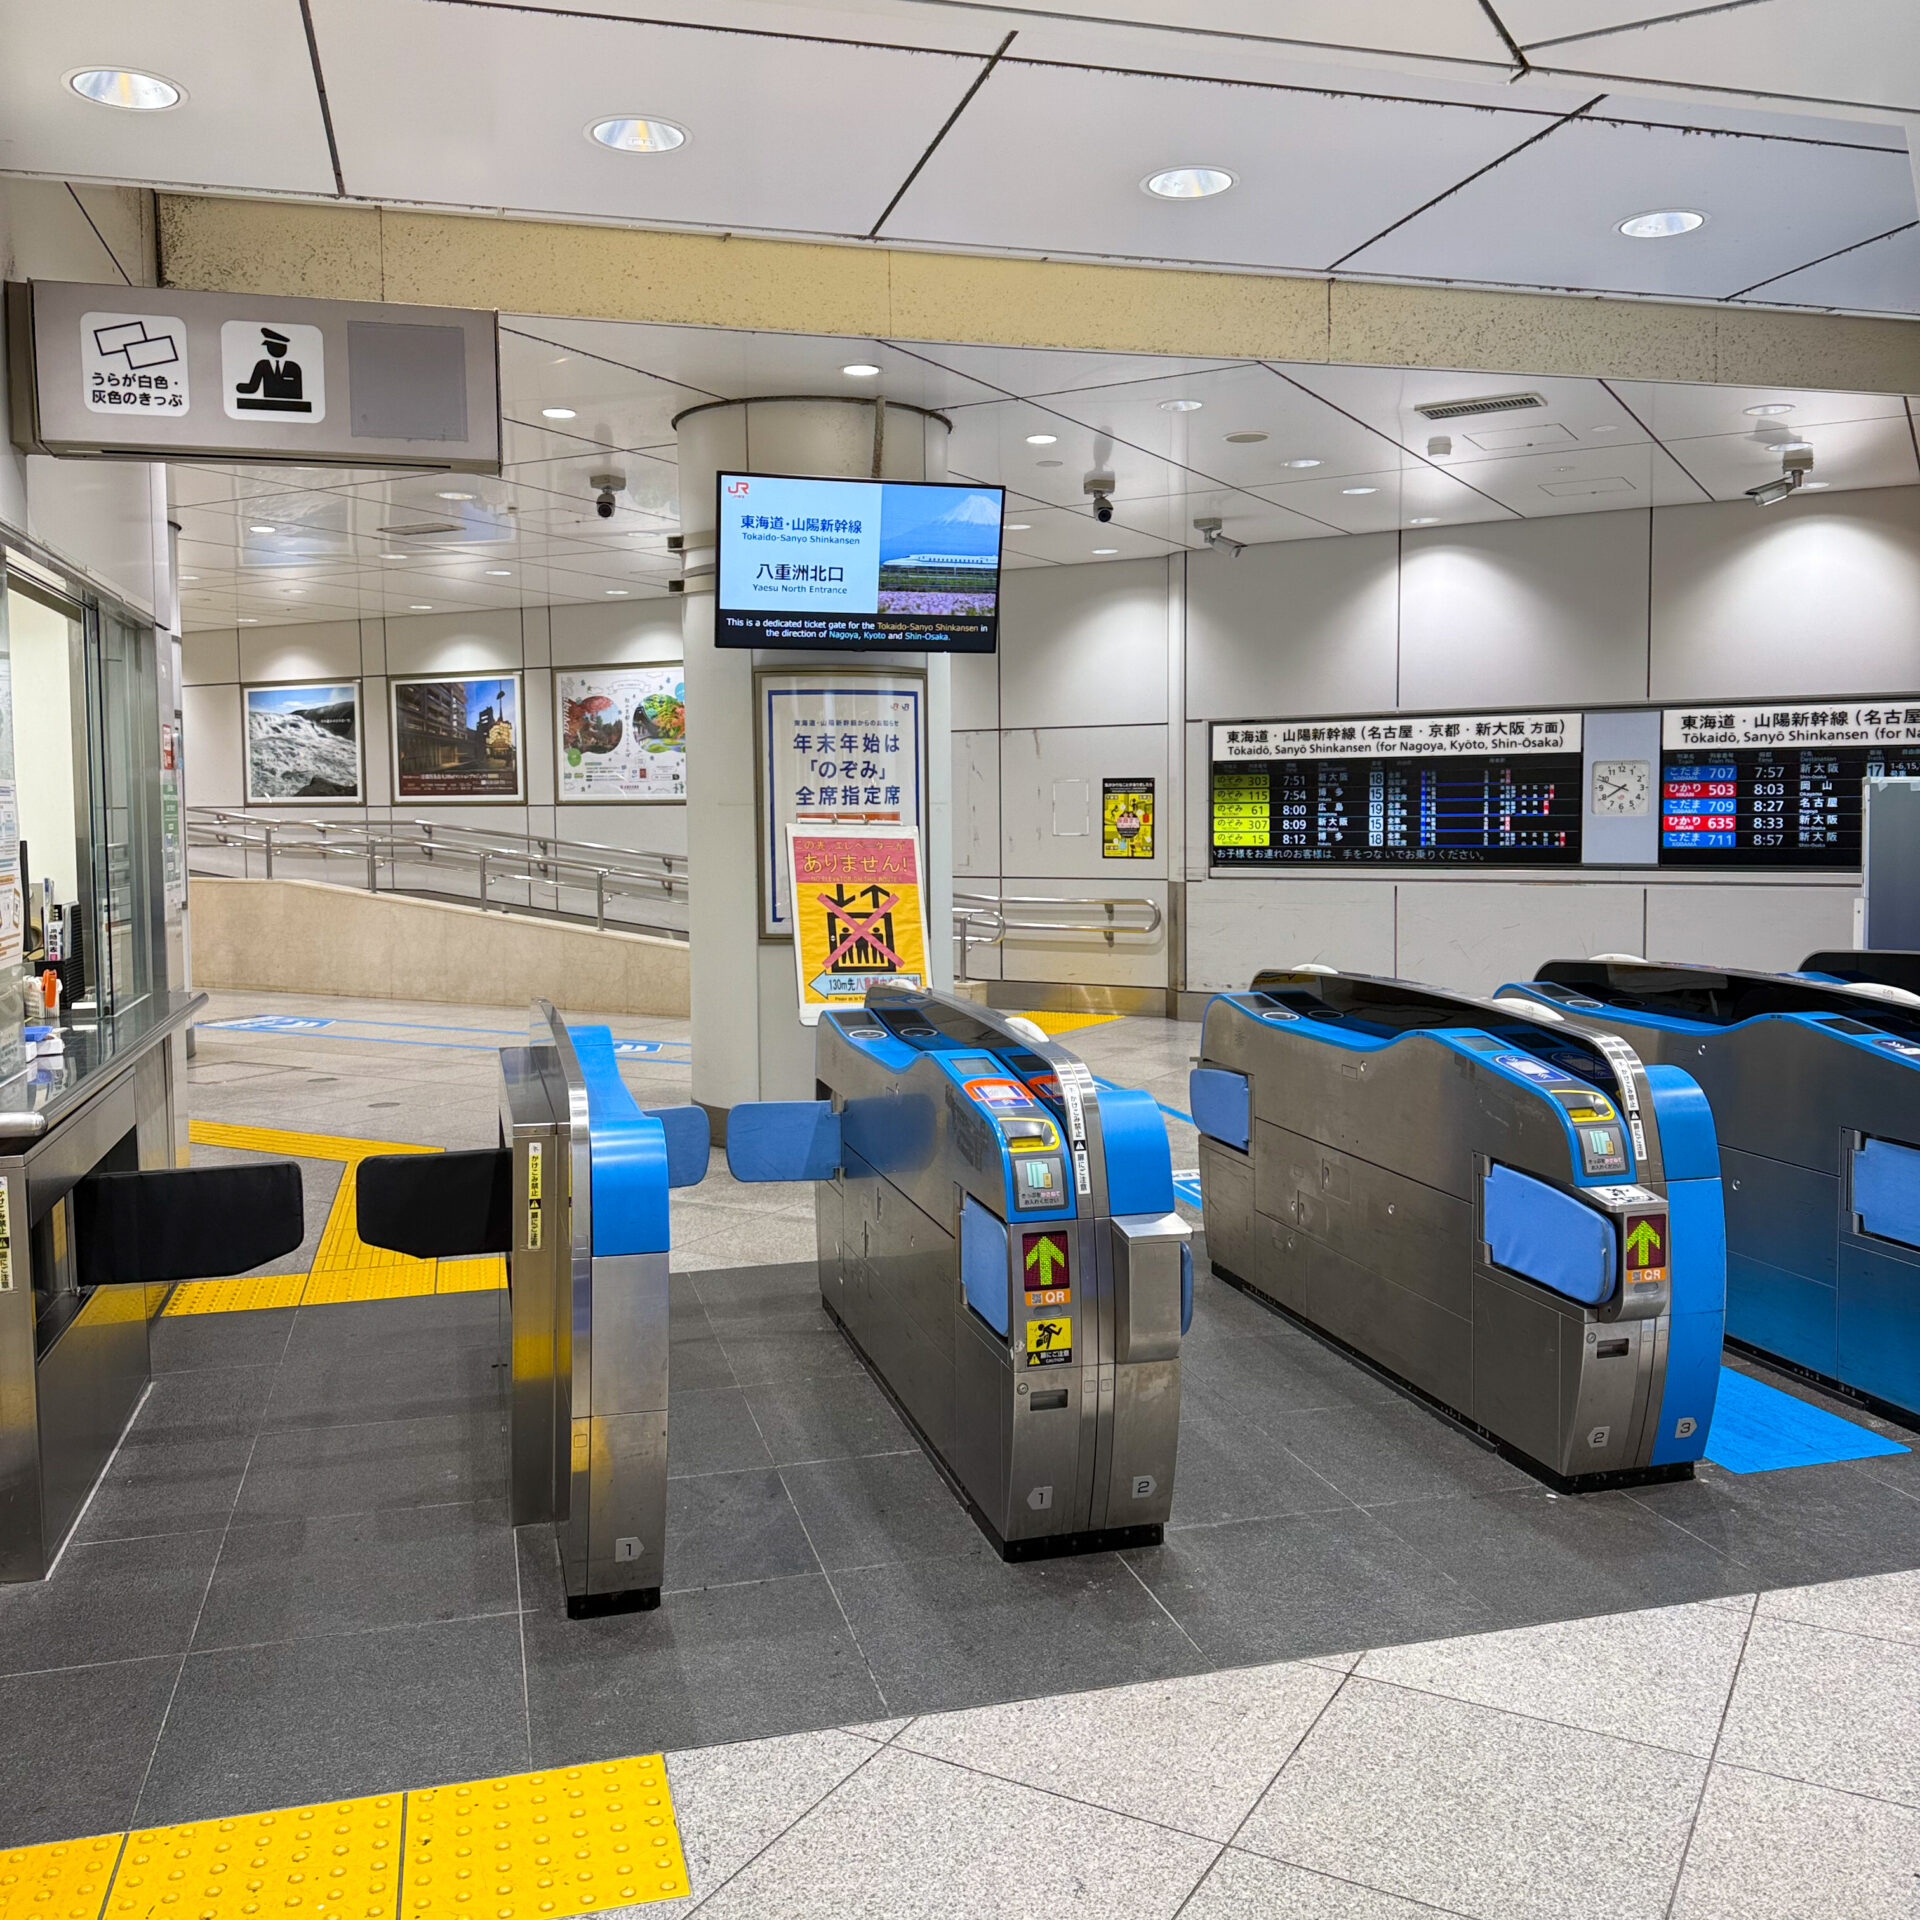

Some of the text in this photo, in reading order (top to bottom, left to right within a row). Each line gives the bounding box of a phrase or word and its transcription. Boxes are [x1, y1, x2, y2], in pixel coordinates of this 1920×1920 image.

[92, 372, 178, 389] うらが白色・
[92, 390, 182, 407] 灰色のきっぷ
[728, 482, 749, 494] JR
[741, 515, 862, 534] 東海道・山陽新幹線
[742, 532, 860, 544] Tokaido-Sanyo Shinkansen
[756, 563, 844, 582] 八重洲北口
[753, 584, 847, 594] Yaesu North Entrance
[727, 617, 743, 626] This
[746, 618, 753, 627] is
[763, 618, 802, 628] dedicated
[804, 619, 827, 629] ticket
[828, 620, 847, 632] gate
[848, 620, 860, 630] for
[862, 621, 875, 630] the
[877, 622, 933, 634] Tokaido-Sanyo
[936, 623, 979, 632] Shinkansen
[981, 623, 988, 632] in
[766, 628, 950, 642] the direction of Nagoya, Kyoto and Shin-Osaka.
[1744, 731, 1785, 744] Sanyō
[1789, 728, 1869, 741] Shinkansen
[1875, 727, 1903, 740] (for
[793, 733, 900, 754] 年末年始は
[1275, 744, 1306, 756] Sanyō
[1310, 742, 1371, 754] Shinkansen
[1376, 741, 1397, 752] (for
[1400, 739, 1447, 753] Nagoya,
[1450, 738, 1488, 751] Kyōto,
[810, 759, 886, 780] 「のぞみ」
[1670, 763, 1883, 779] こだま 707 7:57 新大阪 17
[1248, 776, 1268, 786] 303
[1284, 776, 1305, 785] 7:51
[1371, 774, 1382, 785] 18
[1249, 791, 1268, 800] 115
[1284, 790, 1306, 800] 7:54
[1318, 787, 1343, 797] 博多
[1371, 788, 1382, 799] 15
[1669, 780, 1833, 796] ひかり 503 8:03 岡山
[795, 785, 901, 806] 全席指定席
[1217, 805, 1243, 813] のぞみ
[1251, 806, 1263, 815] 61
[1283, 805, 1306, 815] 8:00
[1318, 802, 1343, 811] 広島
[1371, 803, 1382, 814] 19
[1669, 797, 1838, 812] こだま 709 8:27 名古屋
[1217, 819, 1243, 827] のぞみ
[1249, 820, 1268, 829] 307
[1283, 820, 1306, 830] 8:09
[1318, 817, 1348, 826] 新大阪
[1371, 819, 1382, 830] 15
[1668, 815, 1838, 829] ひかり 635 8:33 新大阪
[1253, 834, 1264, 844] 15
[1283, 834, 1306, 845] 8:12
[1318, 832, 1343, 841] 博多
[1371, 834, 1382, 845] 18
[1669, 832, 1838, 846] こだま 711 8:57 新大阪
[804, 853, 908, 873] ありません!
[1644, 1269, 1661, 1281] QR
[1045, 1290, 1065, 1303] QR
[1680, 1422, 1691, 1433] 3
[1593, 1431, 1605, 1443] 2
[1137, 1480, 1150, 1494] 2
[1037, 1492, 1044, 1505] 1
[625, 1542, 633, 1557] 1
